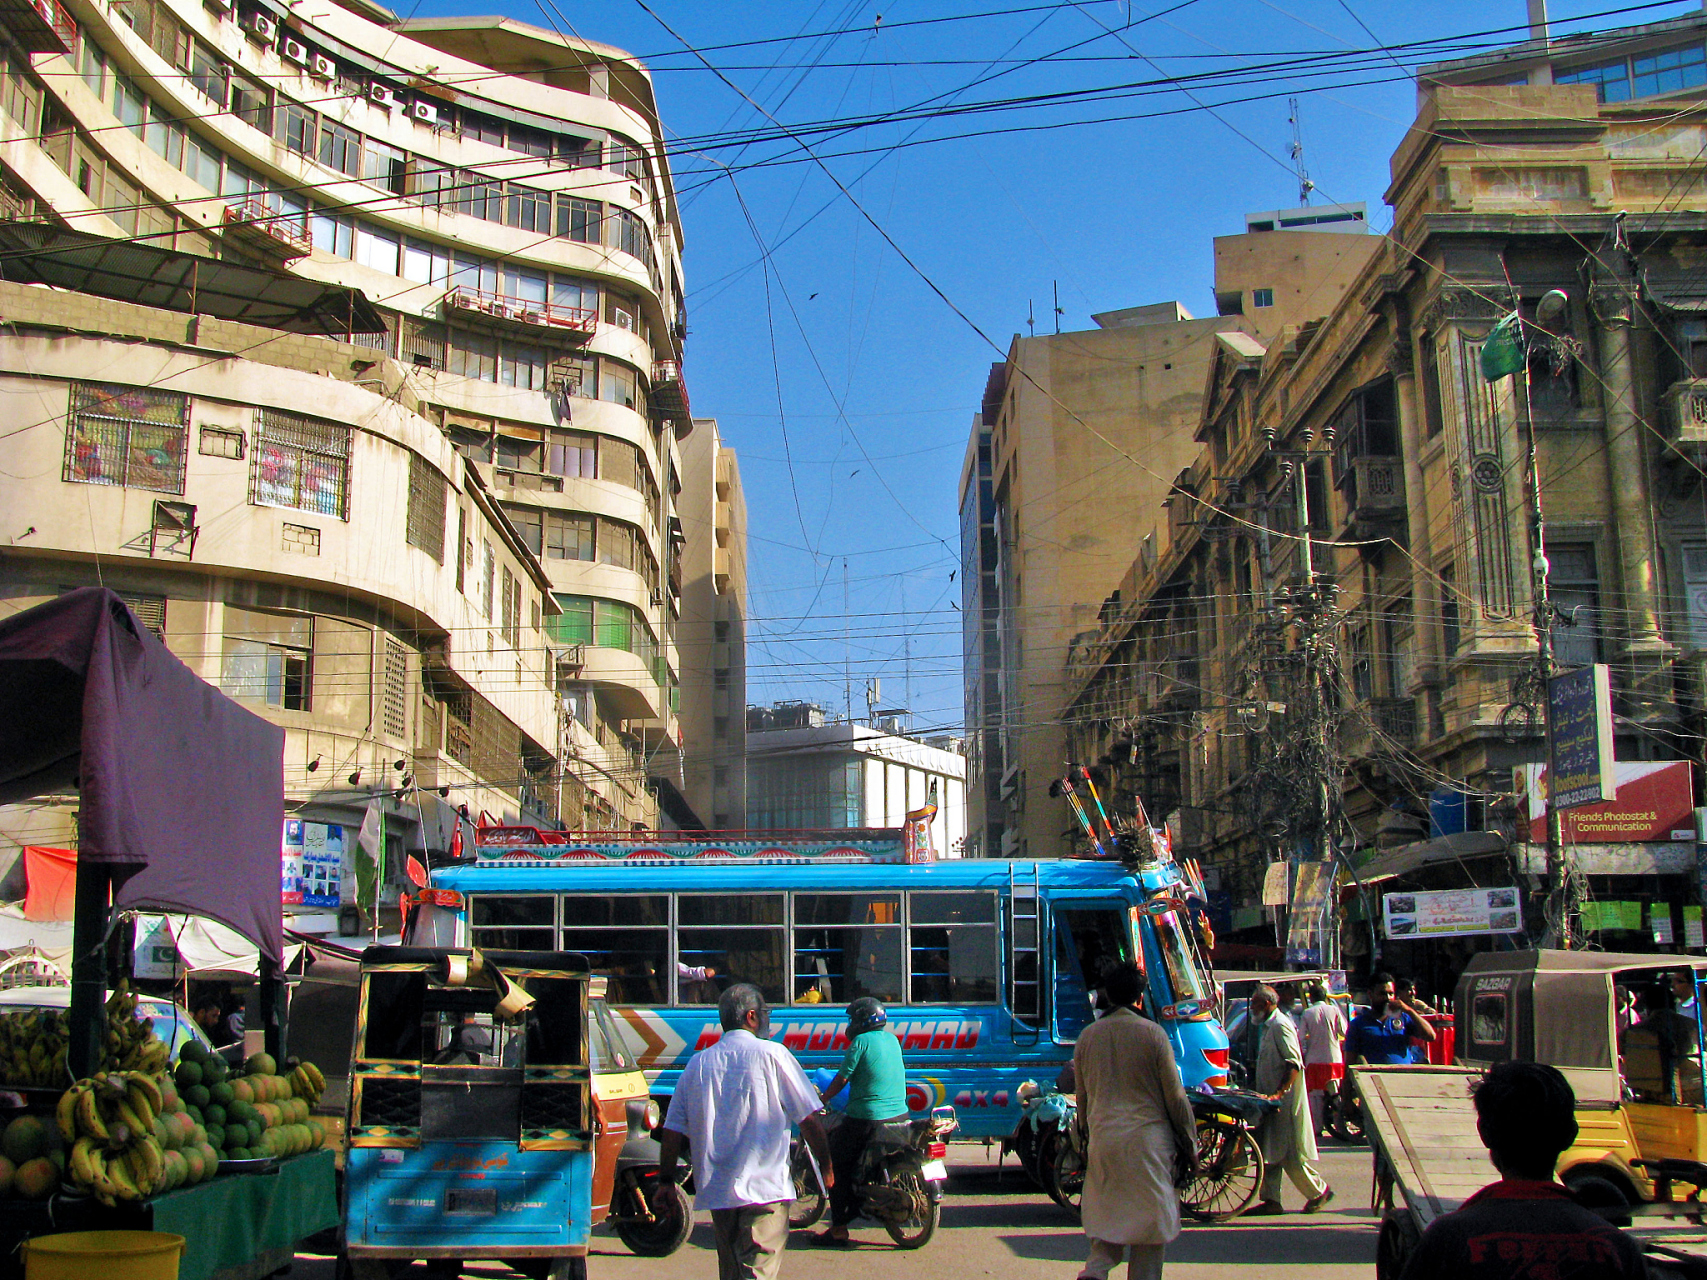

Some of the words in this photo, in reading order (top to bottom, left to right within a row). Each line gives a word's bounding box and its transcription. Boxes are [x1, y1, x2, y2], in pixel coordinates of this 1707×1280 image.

[1568, 812, 1603, 822] Friends
[1604, 811, 1649, 821] Photostat
[1650, 811, 1657, 820] &
[1577, 821, 1652, 832] Communication
[1475, 977, 1512, 990] SAZGAR
[781, 1021, 983, 1050] MOHMMAD
[953, 1089, 1009, 1108] 4X4
